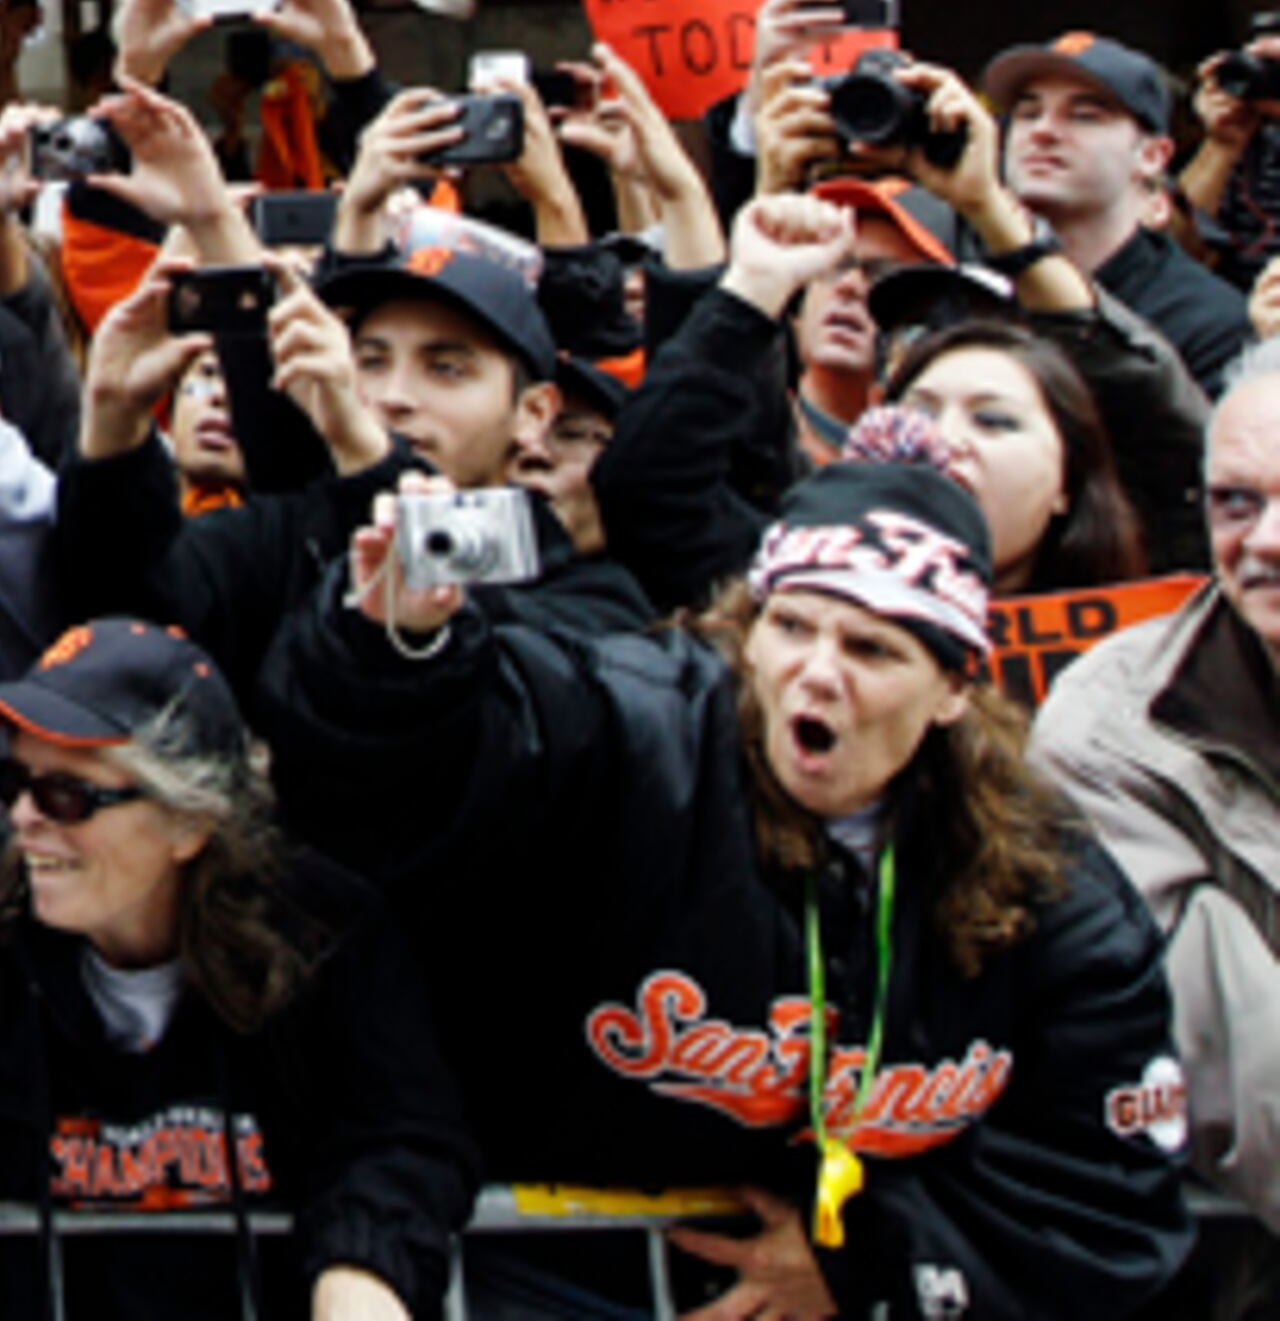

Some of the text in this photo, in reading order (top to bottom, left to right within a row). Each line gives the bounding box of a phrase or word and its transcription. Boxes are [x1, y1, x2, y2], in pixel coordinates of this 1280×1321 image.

[633, 14, 844, 78] TOD
[988, 597, 1118, 646] RLD
[585, 968, 770, 1094] San
[50, 1123, 271, 1195] HAMPIOS
